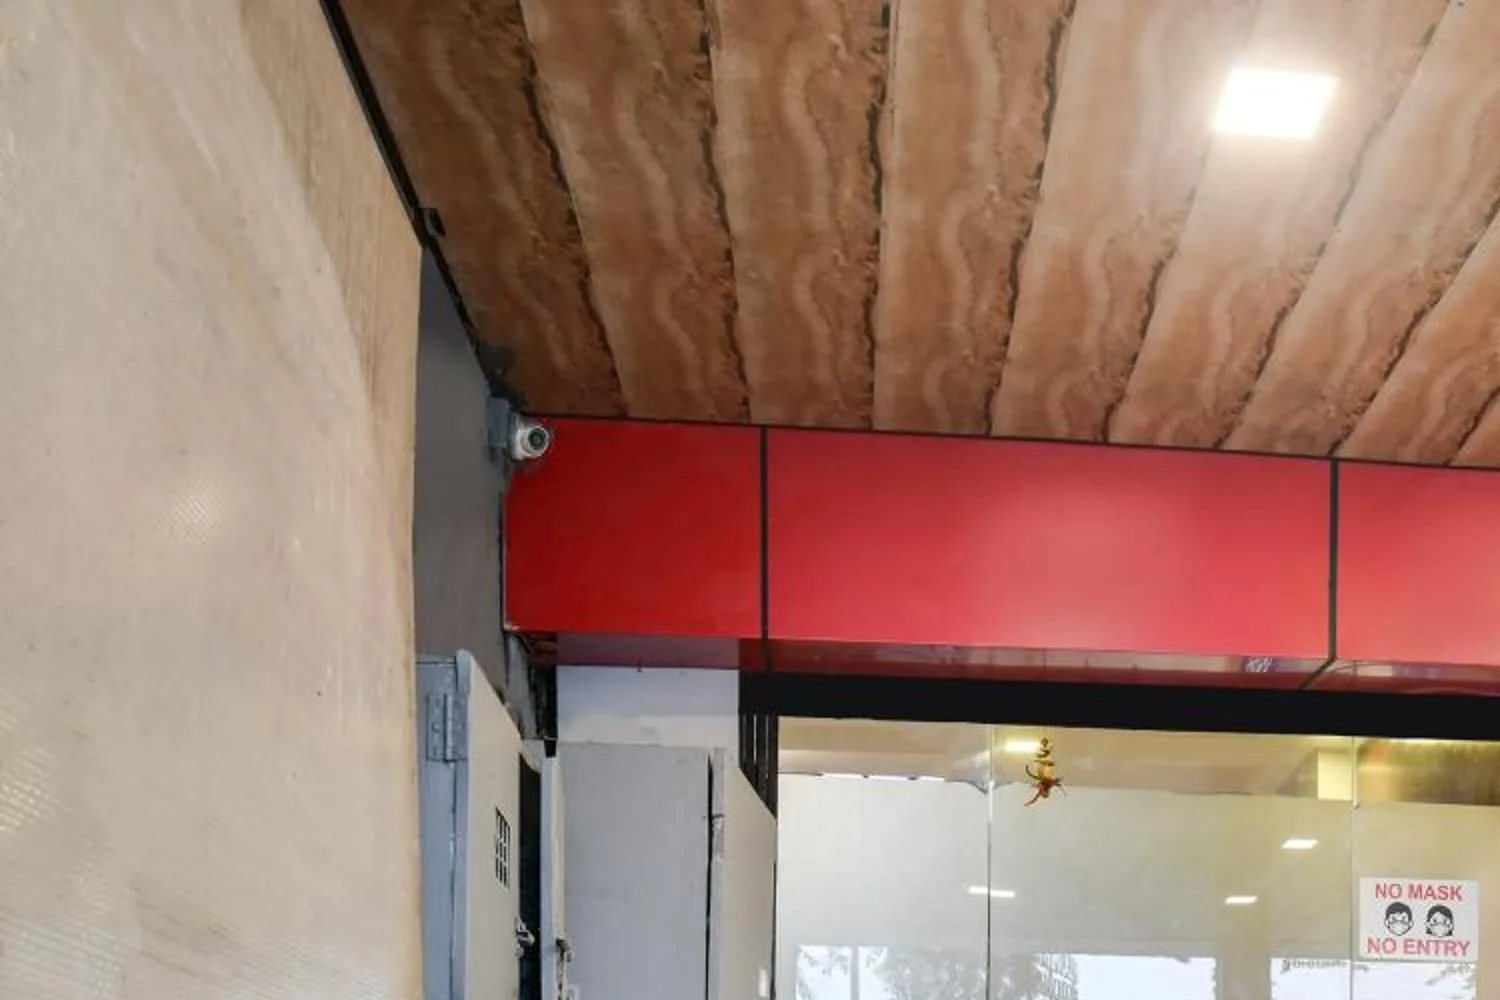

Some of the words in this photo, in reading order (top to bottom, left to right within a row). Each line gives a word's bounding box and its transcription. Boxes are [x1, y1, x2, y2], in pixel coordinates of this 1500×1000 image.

[1375, 883, 1402, 899] NO
[1408, 884, 1463, 901] MASK
[1367, 937, 1397, 954] NO
[1403, 939, 1470, 957] ENTRY
